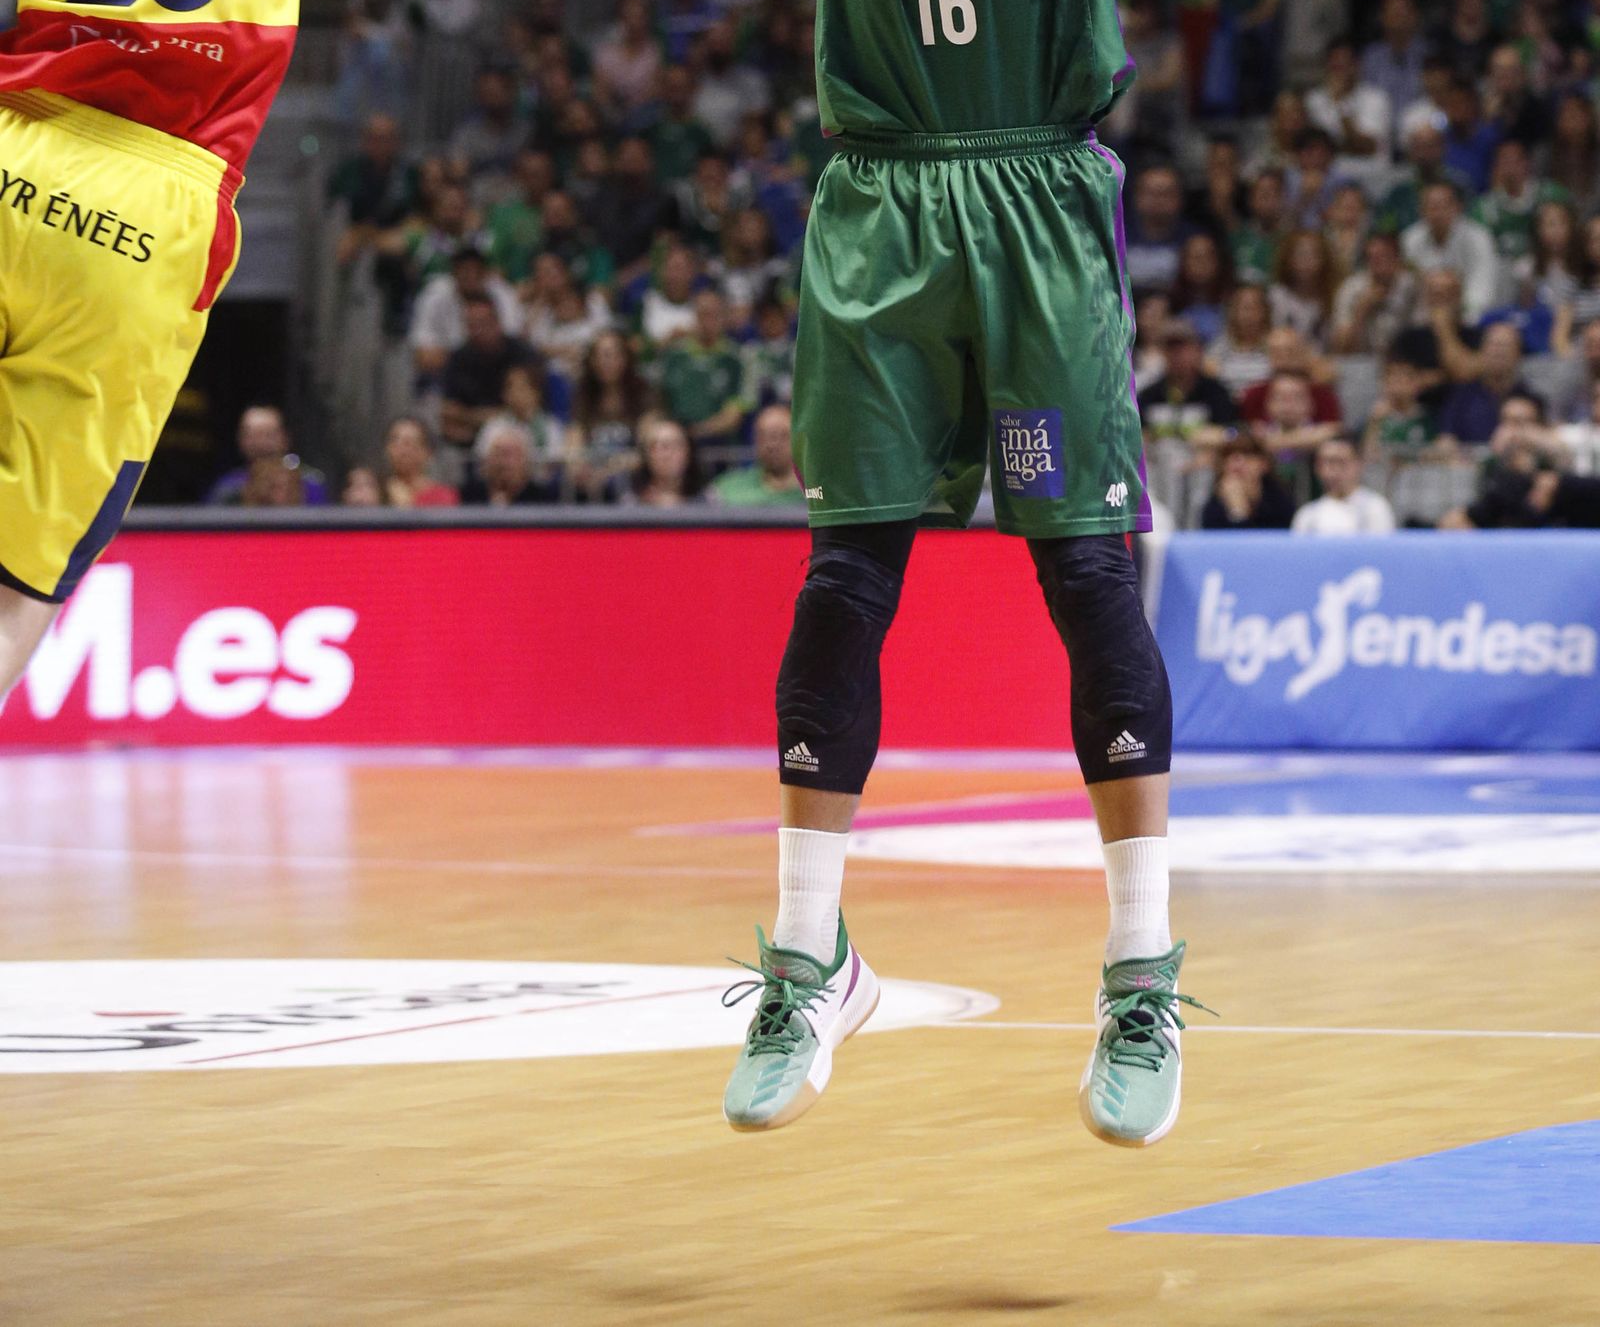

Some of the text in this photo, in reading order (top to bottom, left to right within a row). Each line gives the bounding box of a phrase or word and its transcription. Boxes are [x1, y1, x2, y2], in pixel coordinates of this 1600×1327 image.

[1000, 415, 1021, 427] sabor
[1007, 419, 1052, 450] má
[1001, 441, 1056, 481] laga
[1197, 569, 1314, 685] liga
[784, 752, 819, 764] adidas
[1107, 742, 1146, 755] adidas
